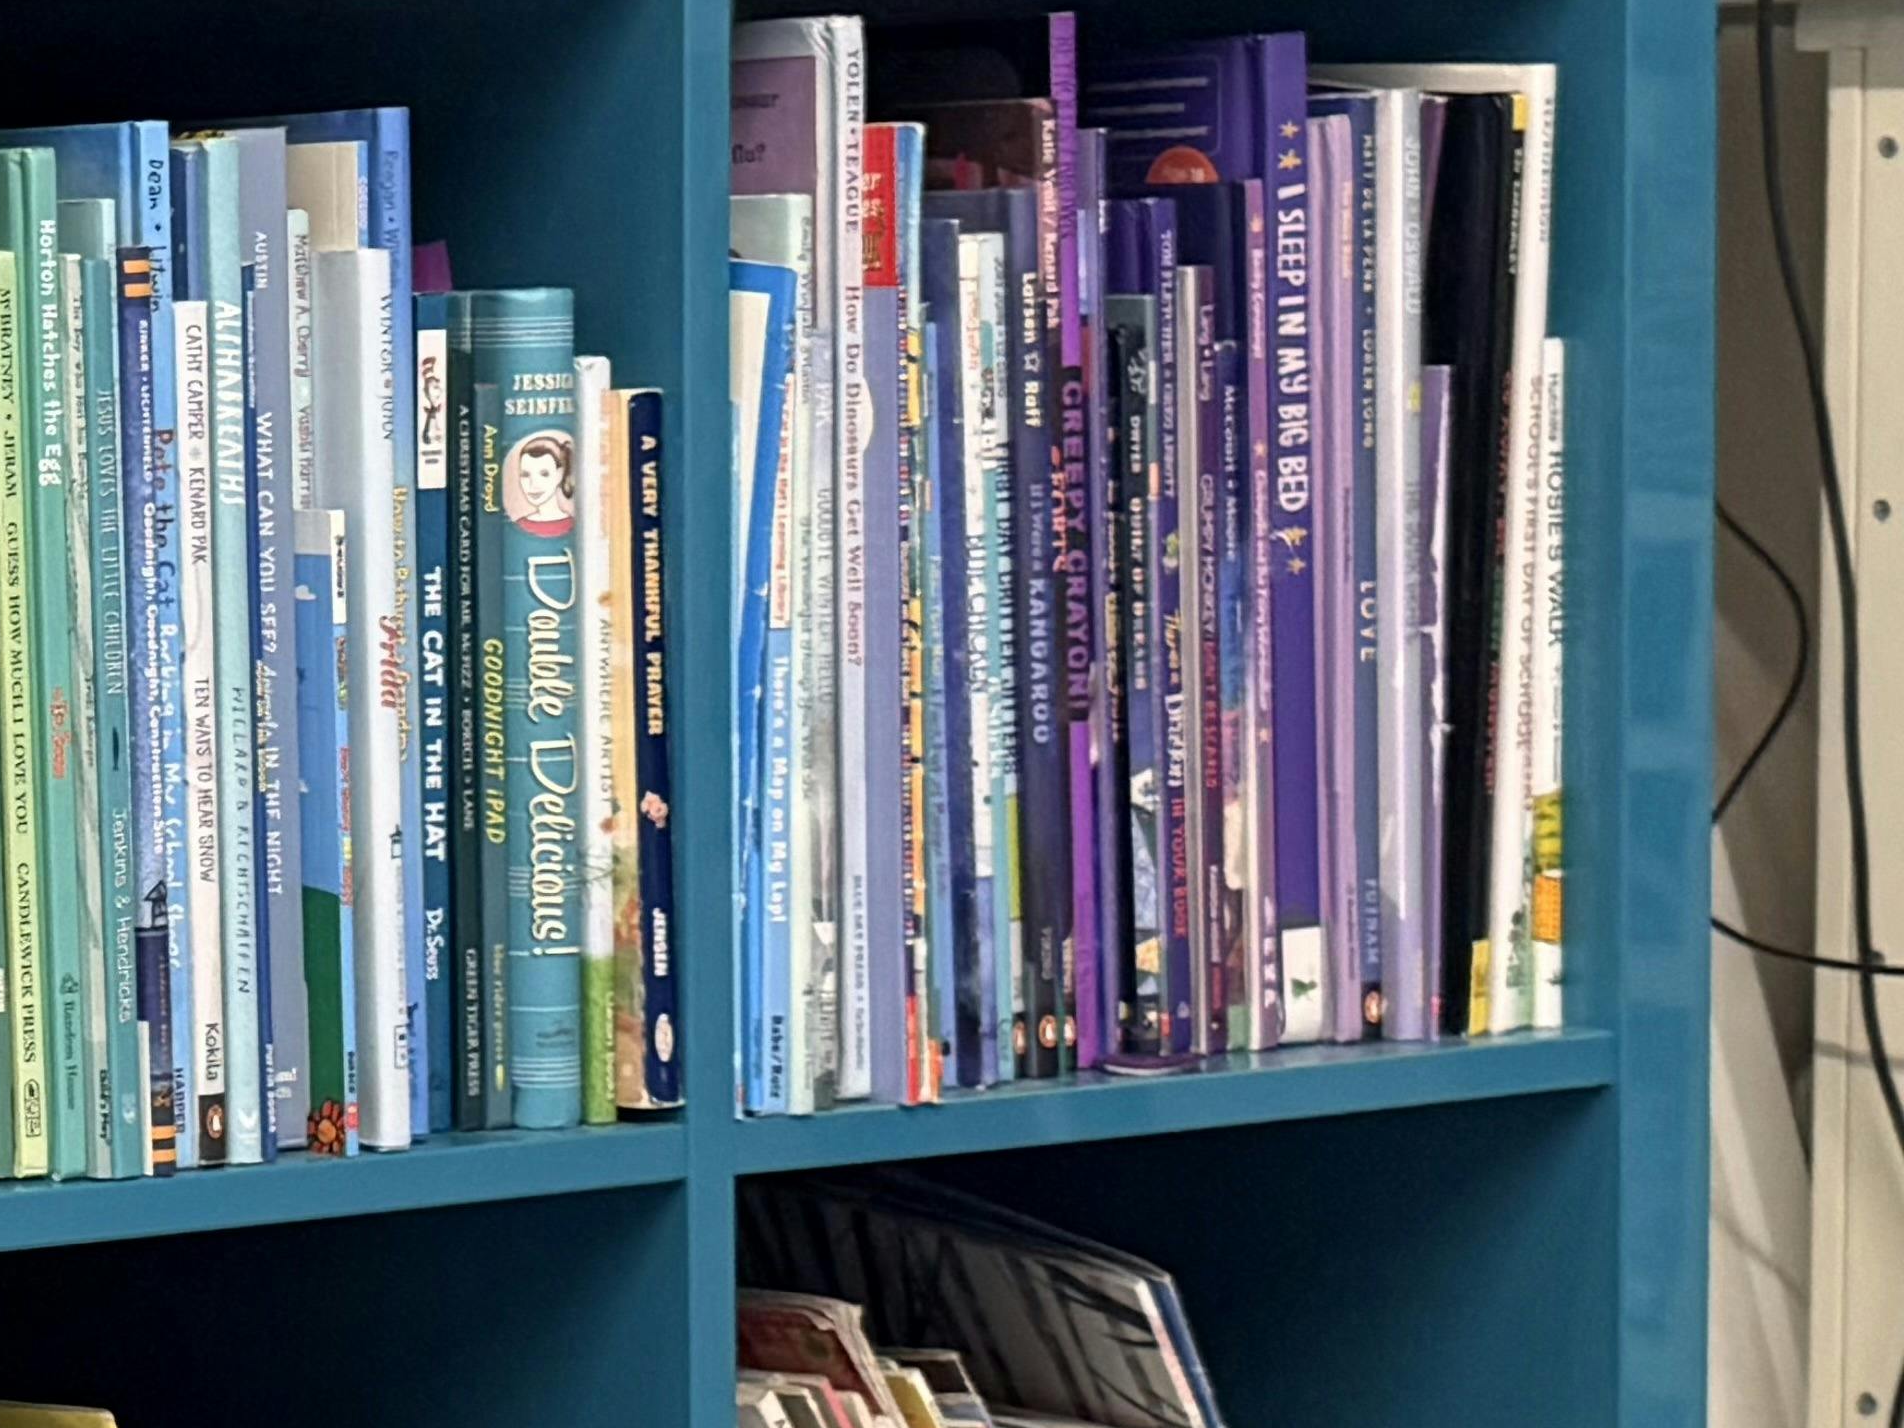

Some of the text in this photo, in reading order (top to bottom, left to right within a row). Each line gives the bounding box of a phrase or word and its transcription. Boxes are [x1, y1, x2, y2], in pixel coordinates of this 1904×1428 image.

[1277, 208, 1308, 287] SLEEP
[843, 284, 862, 335] How
[1278, 295, 1307, 337] IN
[37, 218, 63, 487] Horton Hatches the Egg
[843, 342, 862, 374] Do
[1278, 346, 1308, 394] MY
[1280, 403, 1309, 448] BIG
[1280, 456, 1309, 511] BED
[845, 498, 864, 536] Get
[640, 435, 664, 735] A VERY THANKFUL PRAYER
[845, 543, 866, 594] Well
[423, 565, 446, 862] THE CAT IN THE HAT
[482, 637, 506, 782] GOODNIGHT
[525, 547, 582, 959] Double Delicious!
[652, 907, 670, 977] JENSEN
[203, 1021, 222, 1082] Kokila
